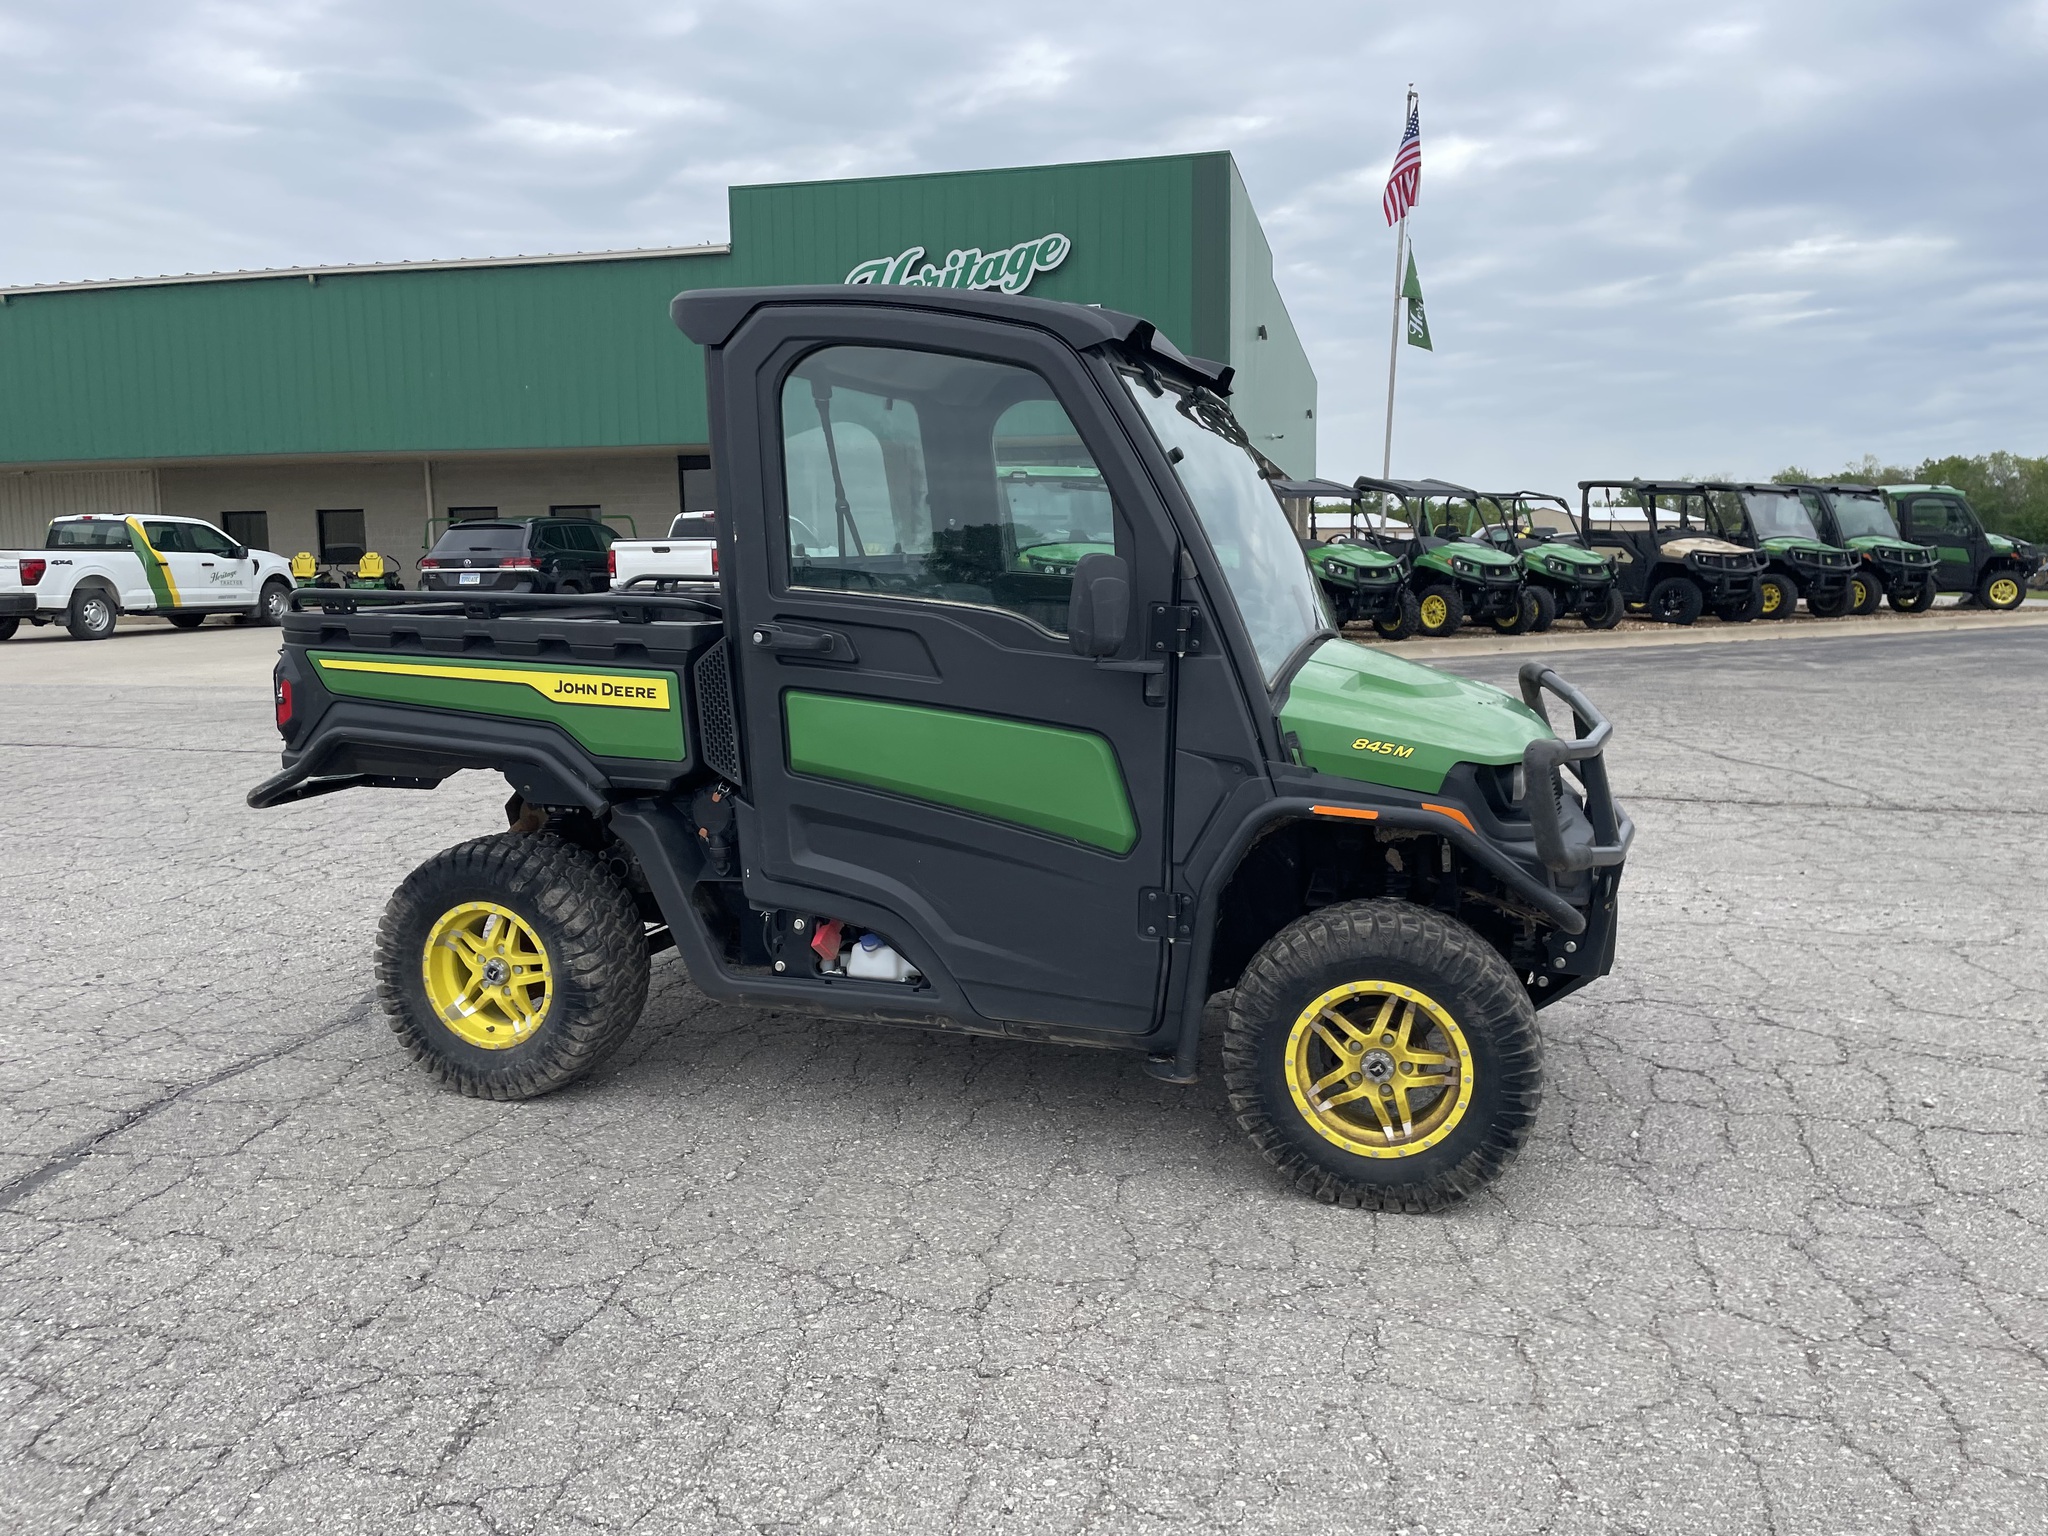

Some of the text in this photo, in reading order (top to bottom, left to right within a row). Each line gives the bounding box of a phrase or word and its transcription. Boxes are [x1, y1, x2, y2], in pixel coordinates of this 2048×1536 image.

[845, 233, 1071, 295] Hritage
[210, 570, 237, 584] Heritage
[554, 680, 656, 699] JOHN DEERE
